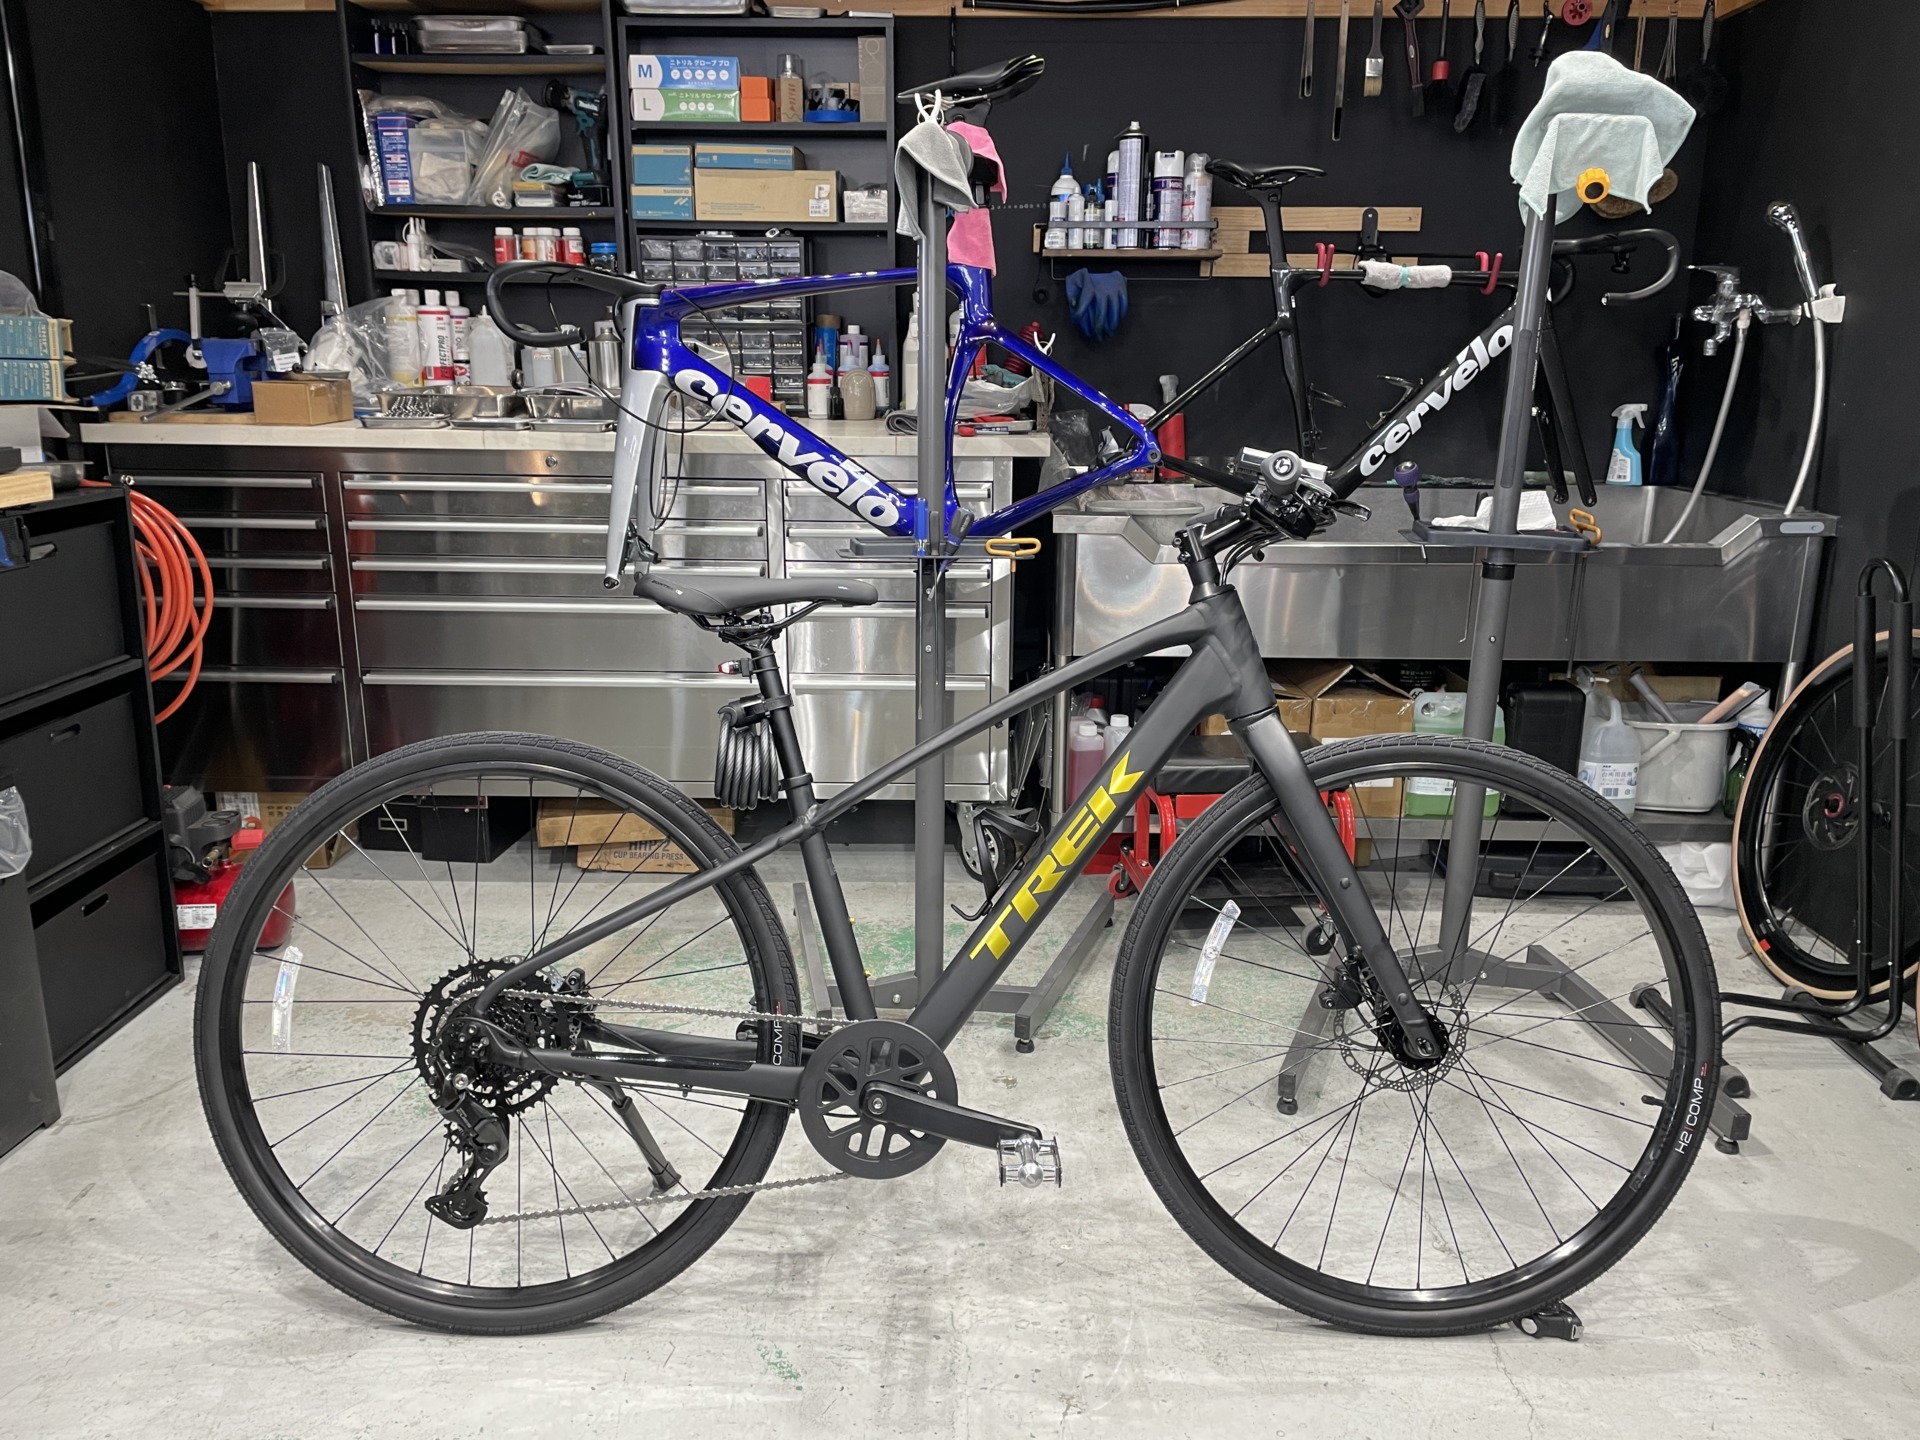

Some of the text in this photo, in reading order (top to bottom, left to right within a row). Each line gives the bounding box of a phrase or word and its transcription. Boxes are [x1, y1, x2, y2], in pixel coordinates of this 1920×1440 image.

[638, 64, 652, 78] M
[643, 98, 651, 111] L
[1360, 325, 1514, 476] cervélo
[613, 851, 684, 860] CUP BEARING PRESS
[969, 750, 1145, 960] TREK
[1674, 1077, 1704, 1154] H2 COMP
